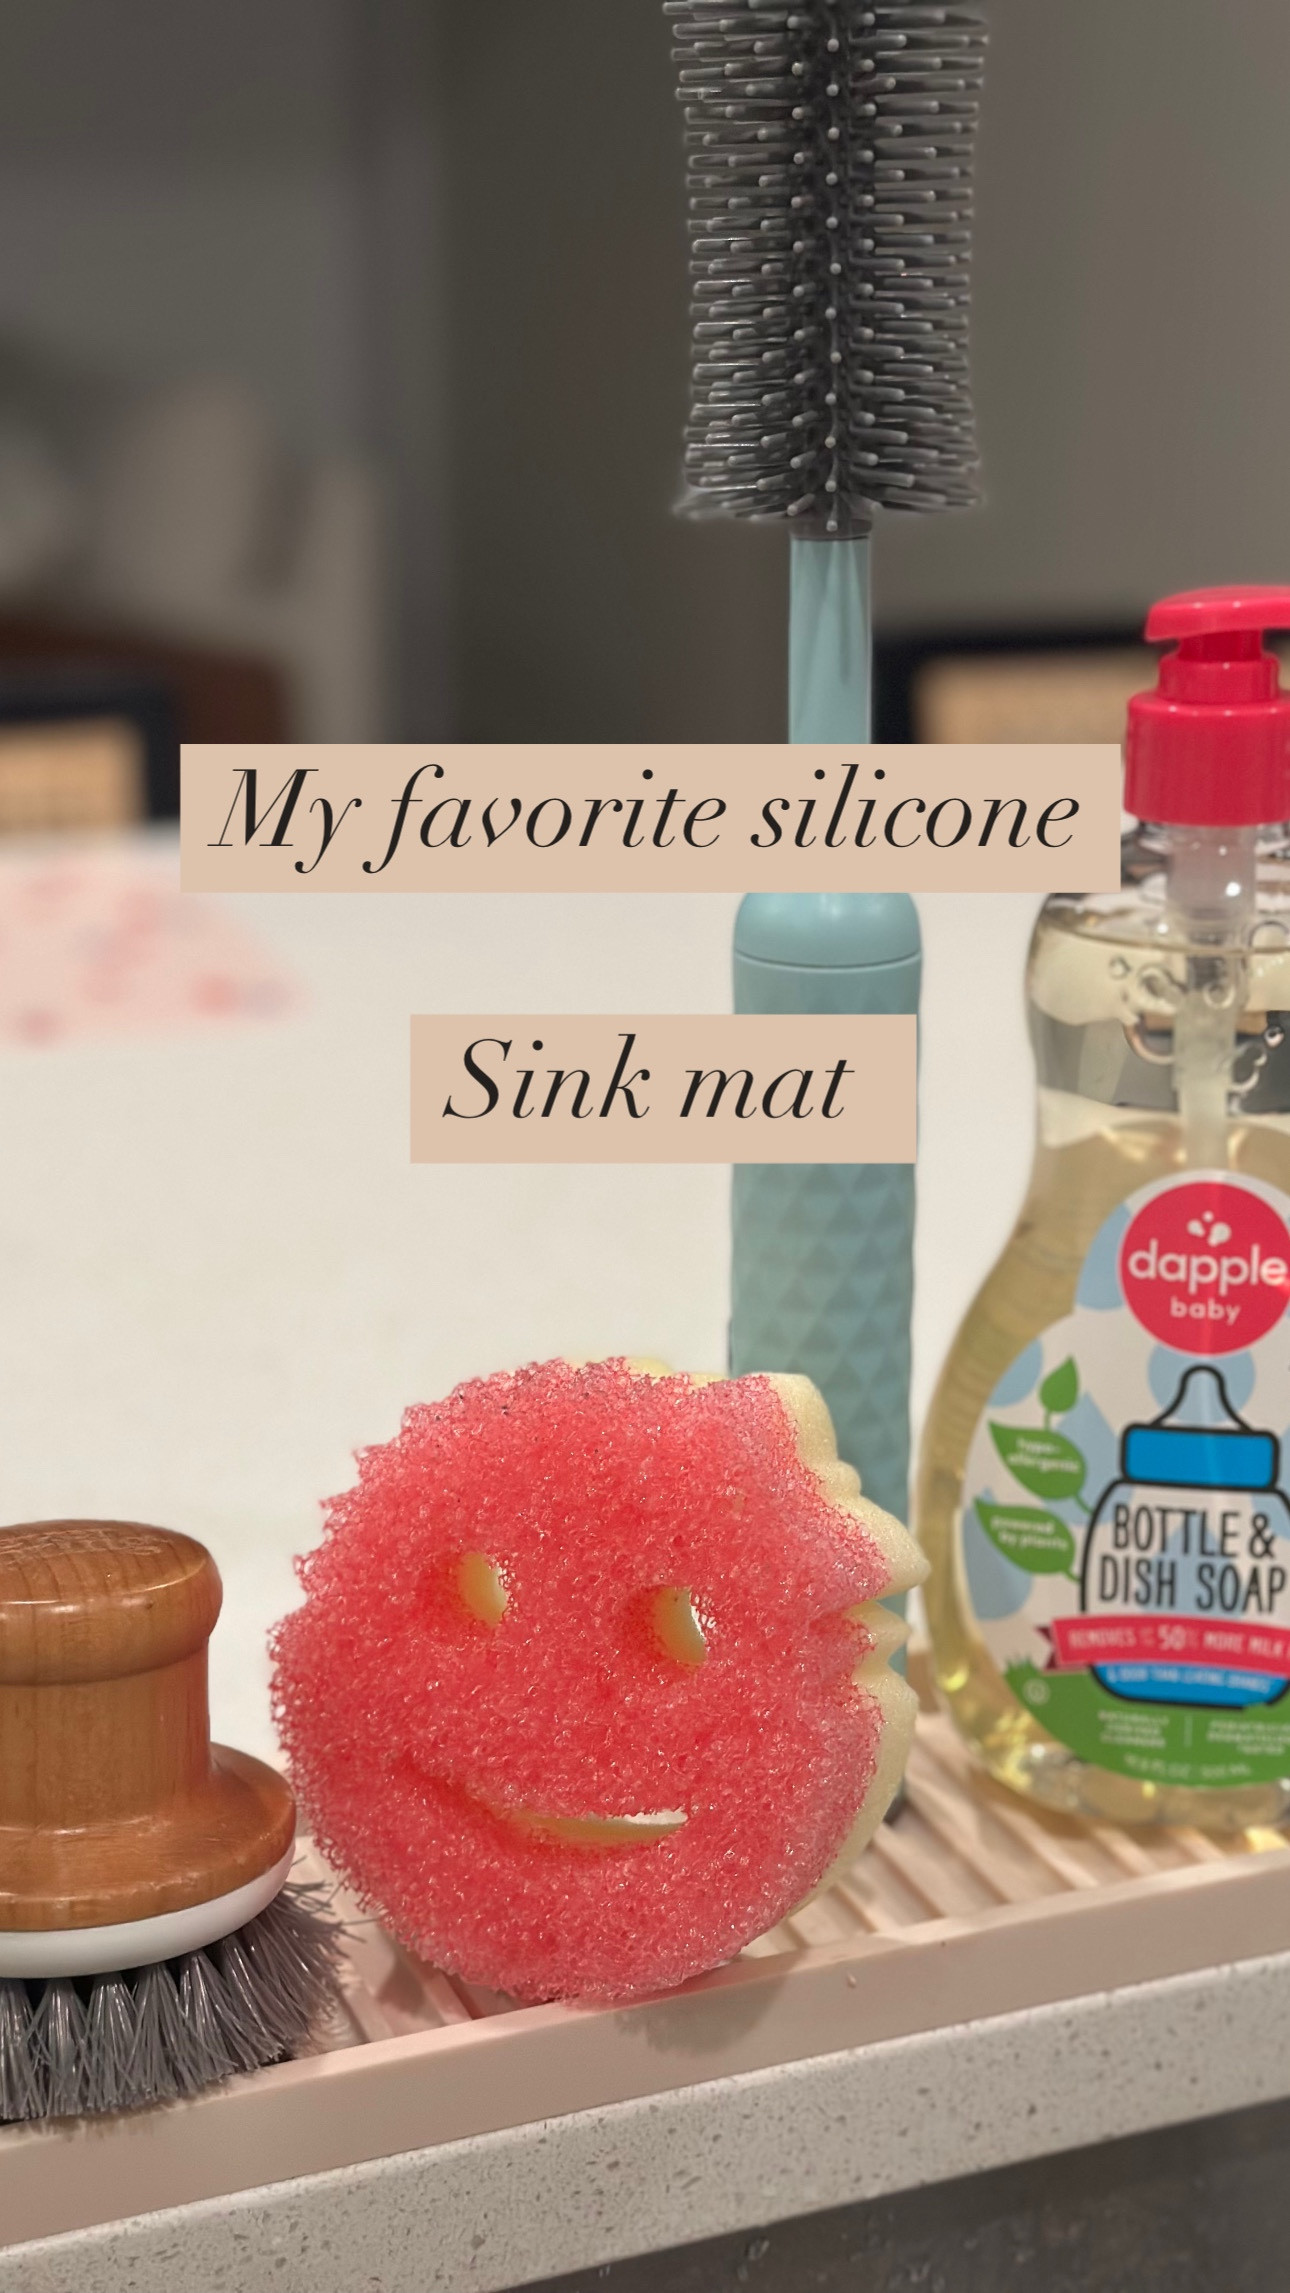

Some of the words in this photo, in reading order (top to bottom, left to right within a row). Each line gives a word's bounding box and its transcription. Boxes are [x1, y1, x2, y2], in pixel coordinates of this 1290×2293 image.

[1127, 1238, 1289, 1297] dapple
[1170, 1296, 1241, 1326] baby
[1112, 1504, 1240, 1558] BOTTLE
[1247, 1513, 1277, 1559] &
[1099, 1554, 1177, 1608] DISH
[1195, 1563, 1287, 1614] SOAP
[1067, 1627, 1137, 1649] REMOVES
[1203, 1630, 1245, 1654] MORE
